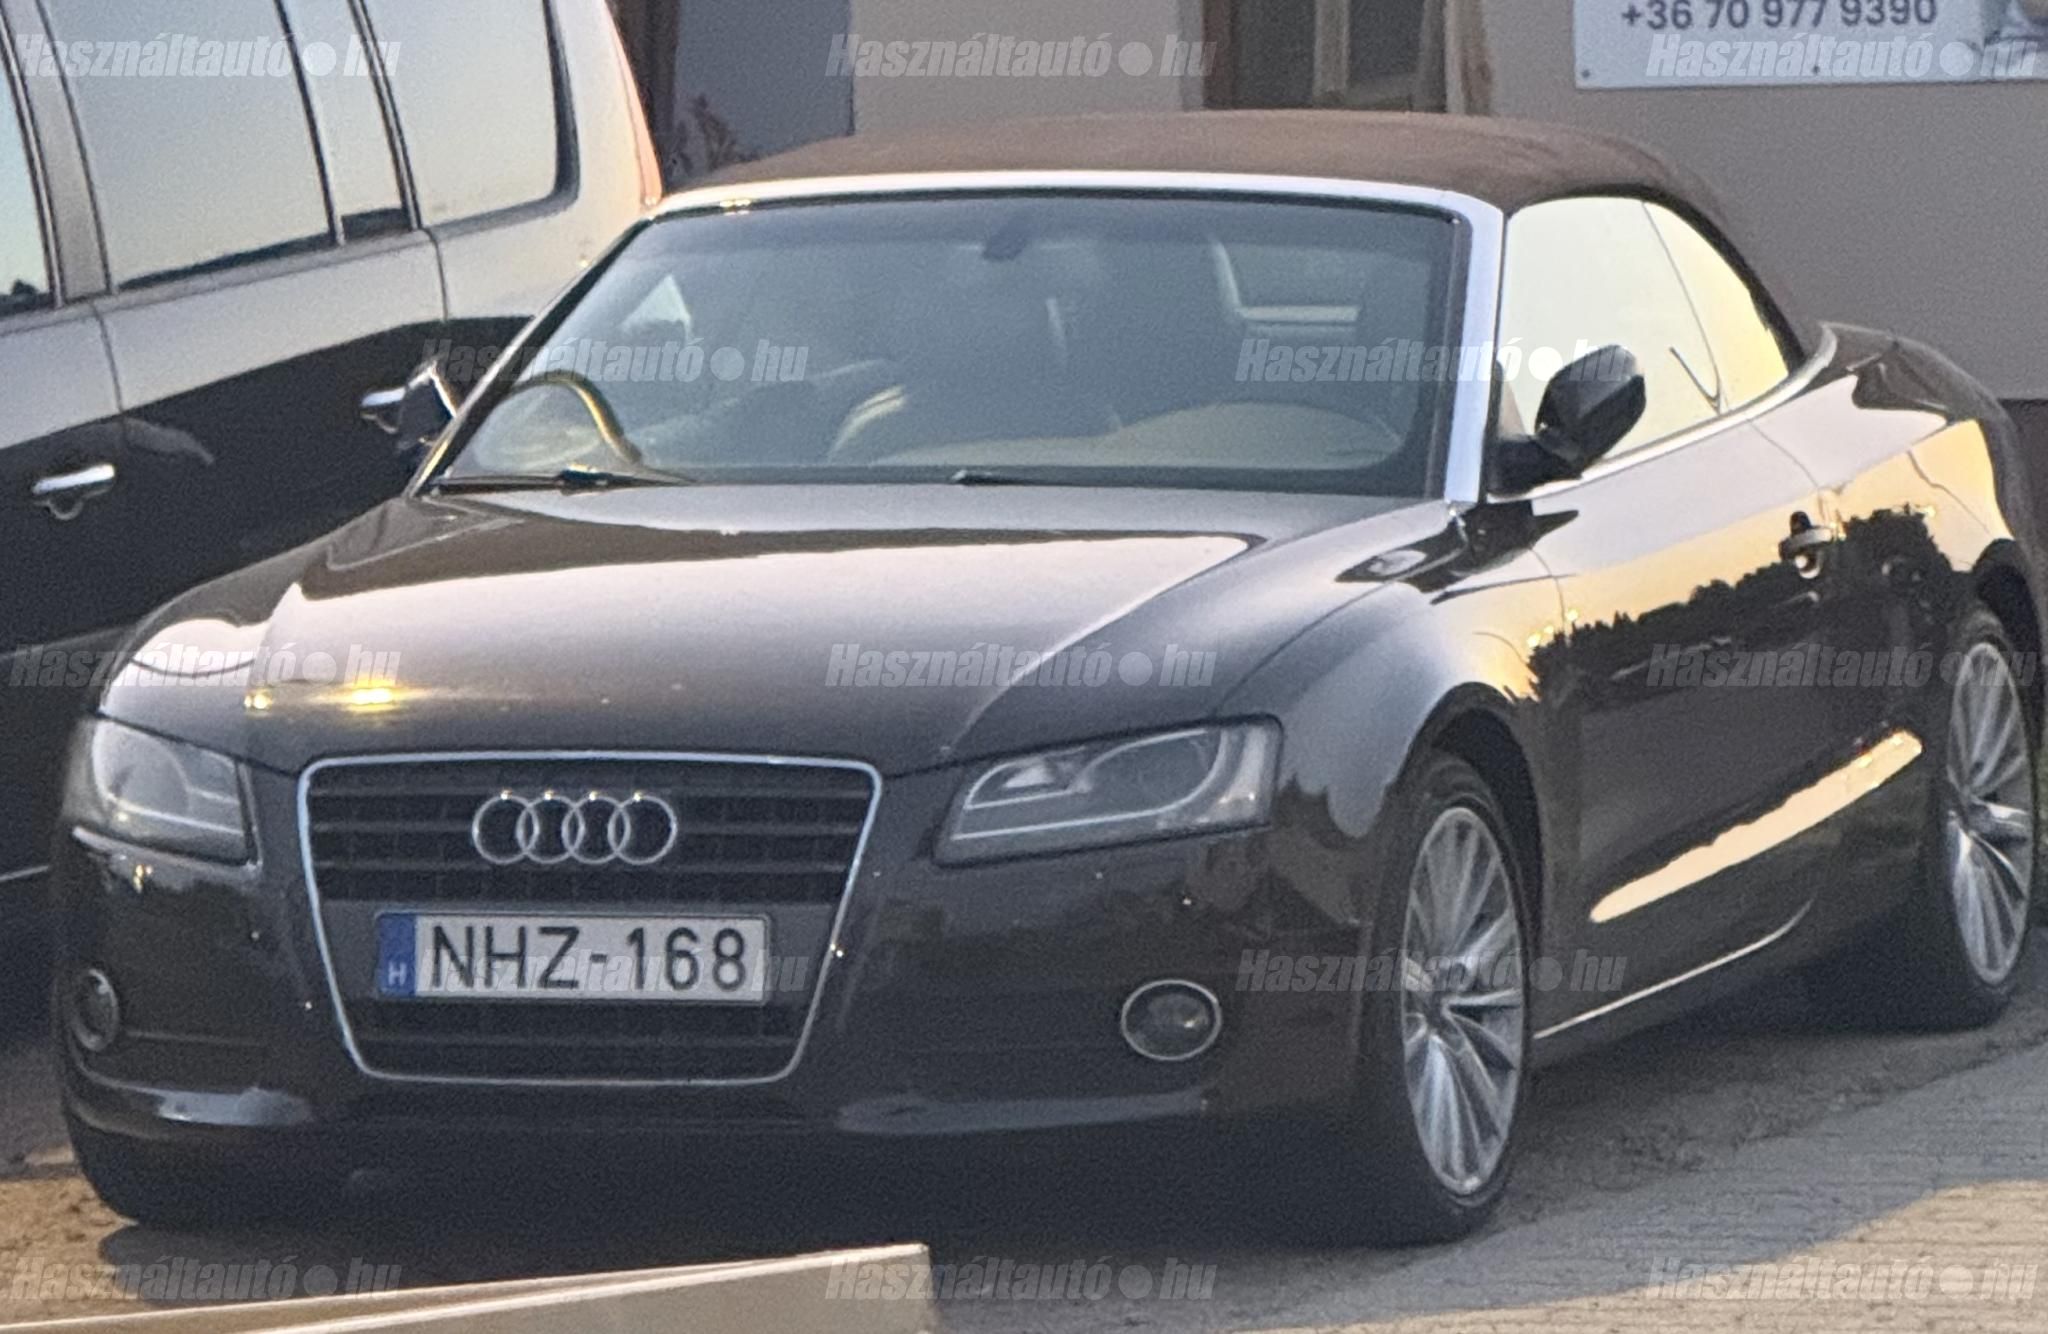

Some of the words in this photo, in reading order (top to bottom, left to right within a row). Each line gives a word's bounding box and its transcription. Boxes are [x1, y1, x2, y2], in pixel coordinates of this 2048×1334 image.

[1621, 0, 1694, 30] +36
[1706, 0, 1750, 28] 70
[1762, 0, 1824, 28] 977
[1841, 0, 1938, 26] 9390
[432, 925, 745, 990] NHZ-168
[387, 968, 407, 985] H
